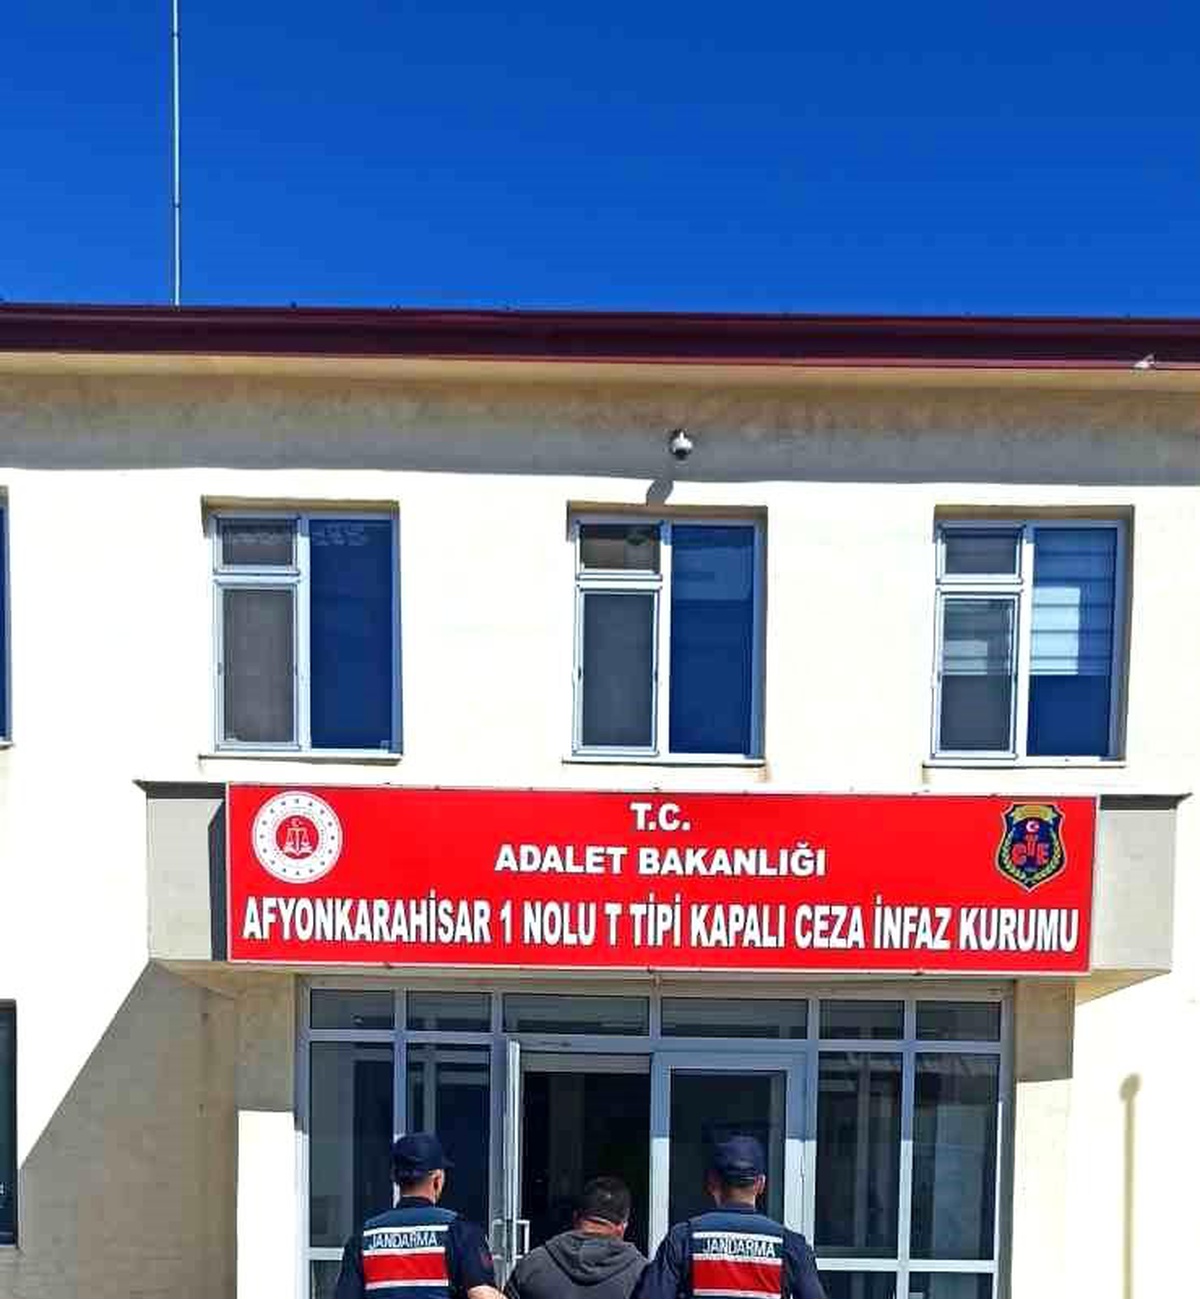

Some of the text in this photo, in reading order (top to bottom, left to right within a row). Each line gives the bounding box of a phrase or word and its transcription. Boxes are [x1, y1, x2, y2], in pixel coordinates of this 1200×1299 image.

[629, 802, 691, 831] T.C.
[494, 841, 827, 877] ADALET BAKANLIĞI
[242, 889, 1080, 954] AFYONKARAHİSAR 1 NOLU T TİPİ KAPALI CEZA İNFAZ KURUMU
[368, 1231, 438, 1249] JANDARMA
[702, 1238, 776, 1258] JANDARMA
